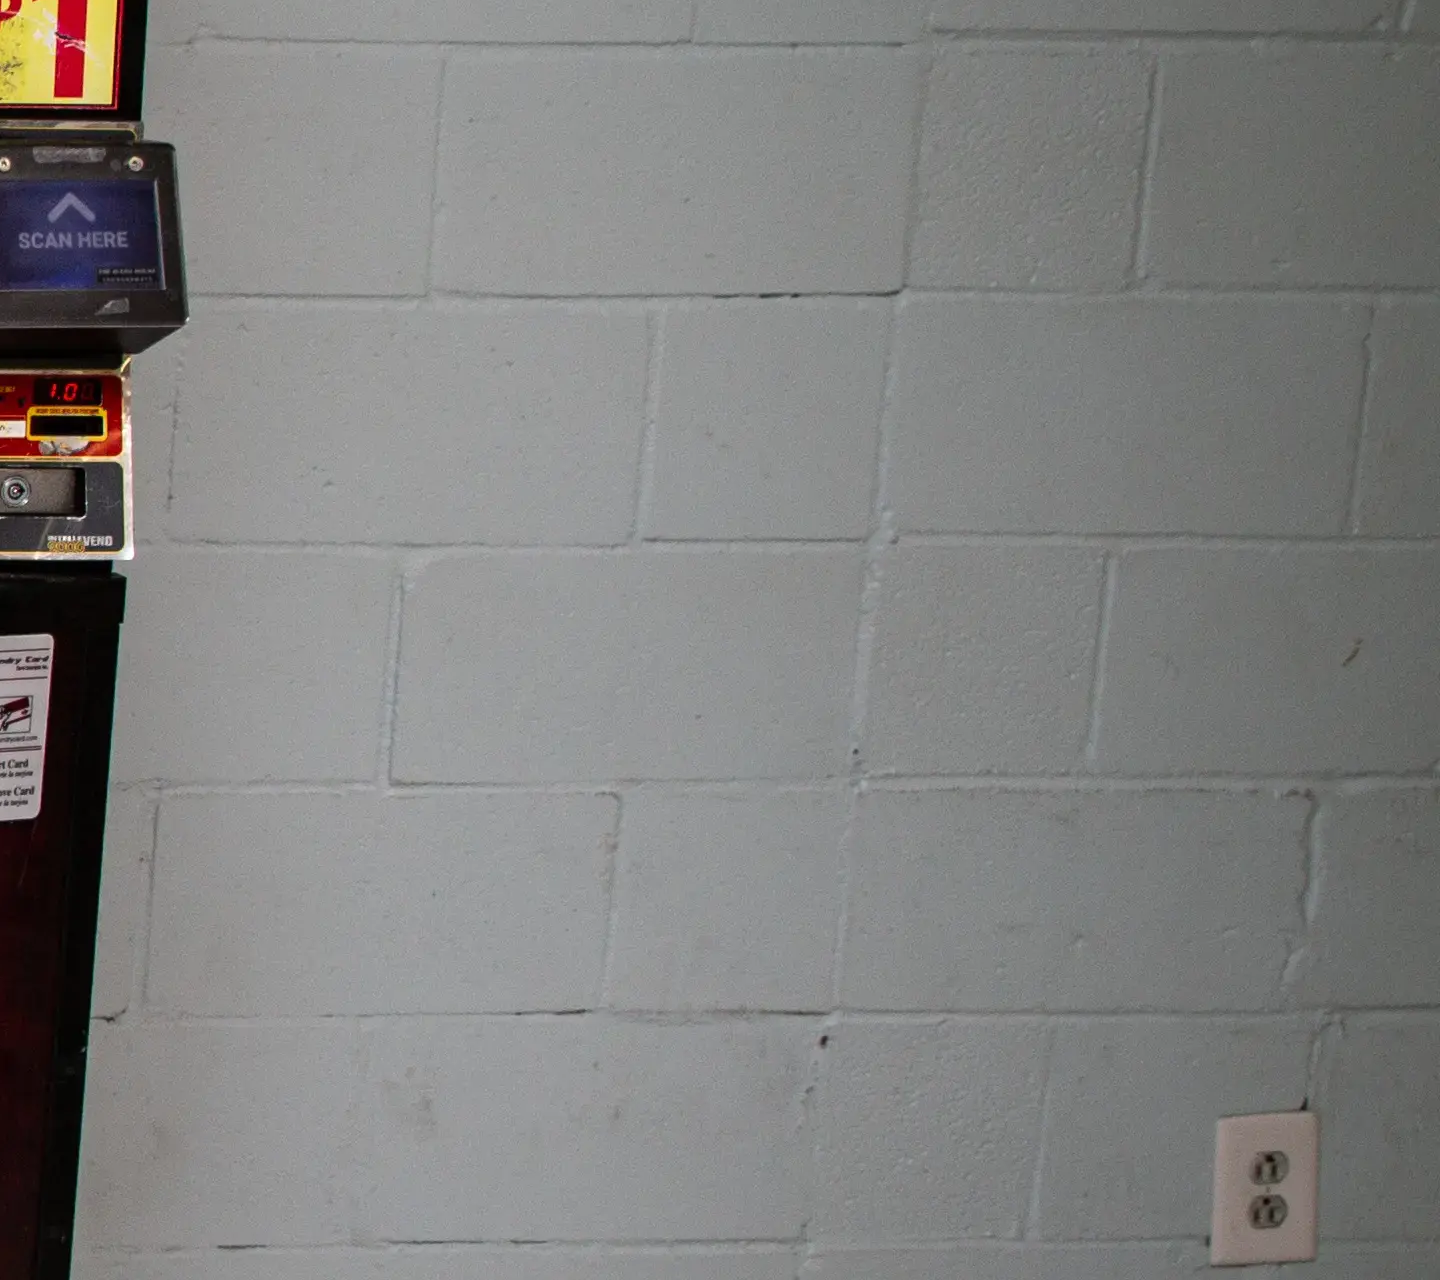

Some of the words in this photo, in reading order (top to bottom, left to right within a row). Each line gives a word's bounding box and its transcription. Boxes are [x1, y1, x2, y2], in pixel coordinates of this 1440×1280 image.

[18, 231, 73, 249] SCAN
[77, 230, 129, 248] HERE
[25, 655, 49, 663] Card
[8, 759, 28, 769] Card
[14, 786, 35, 796] Card
